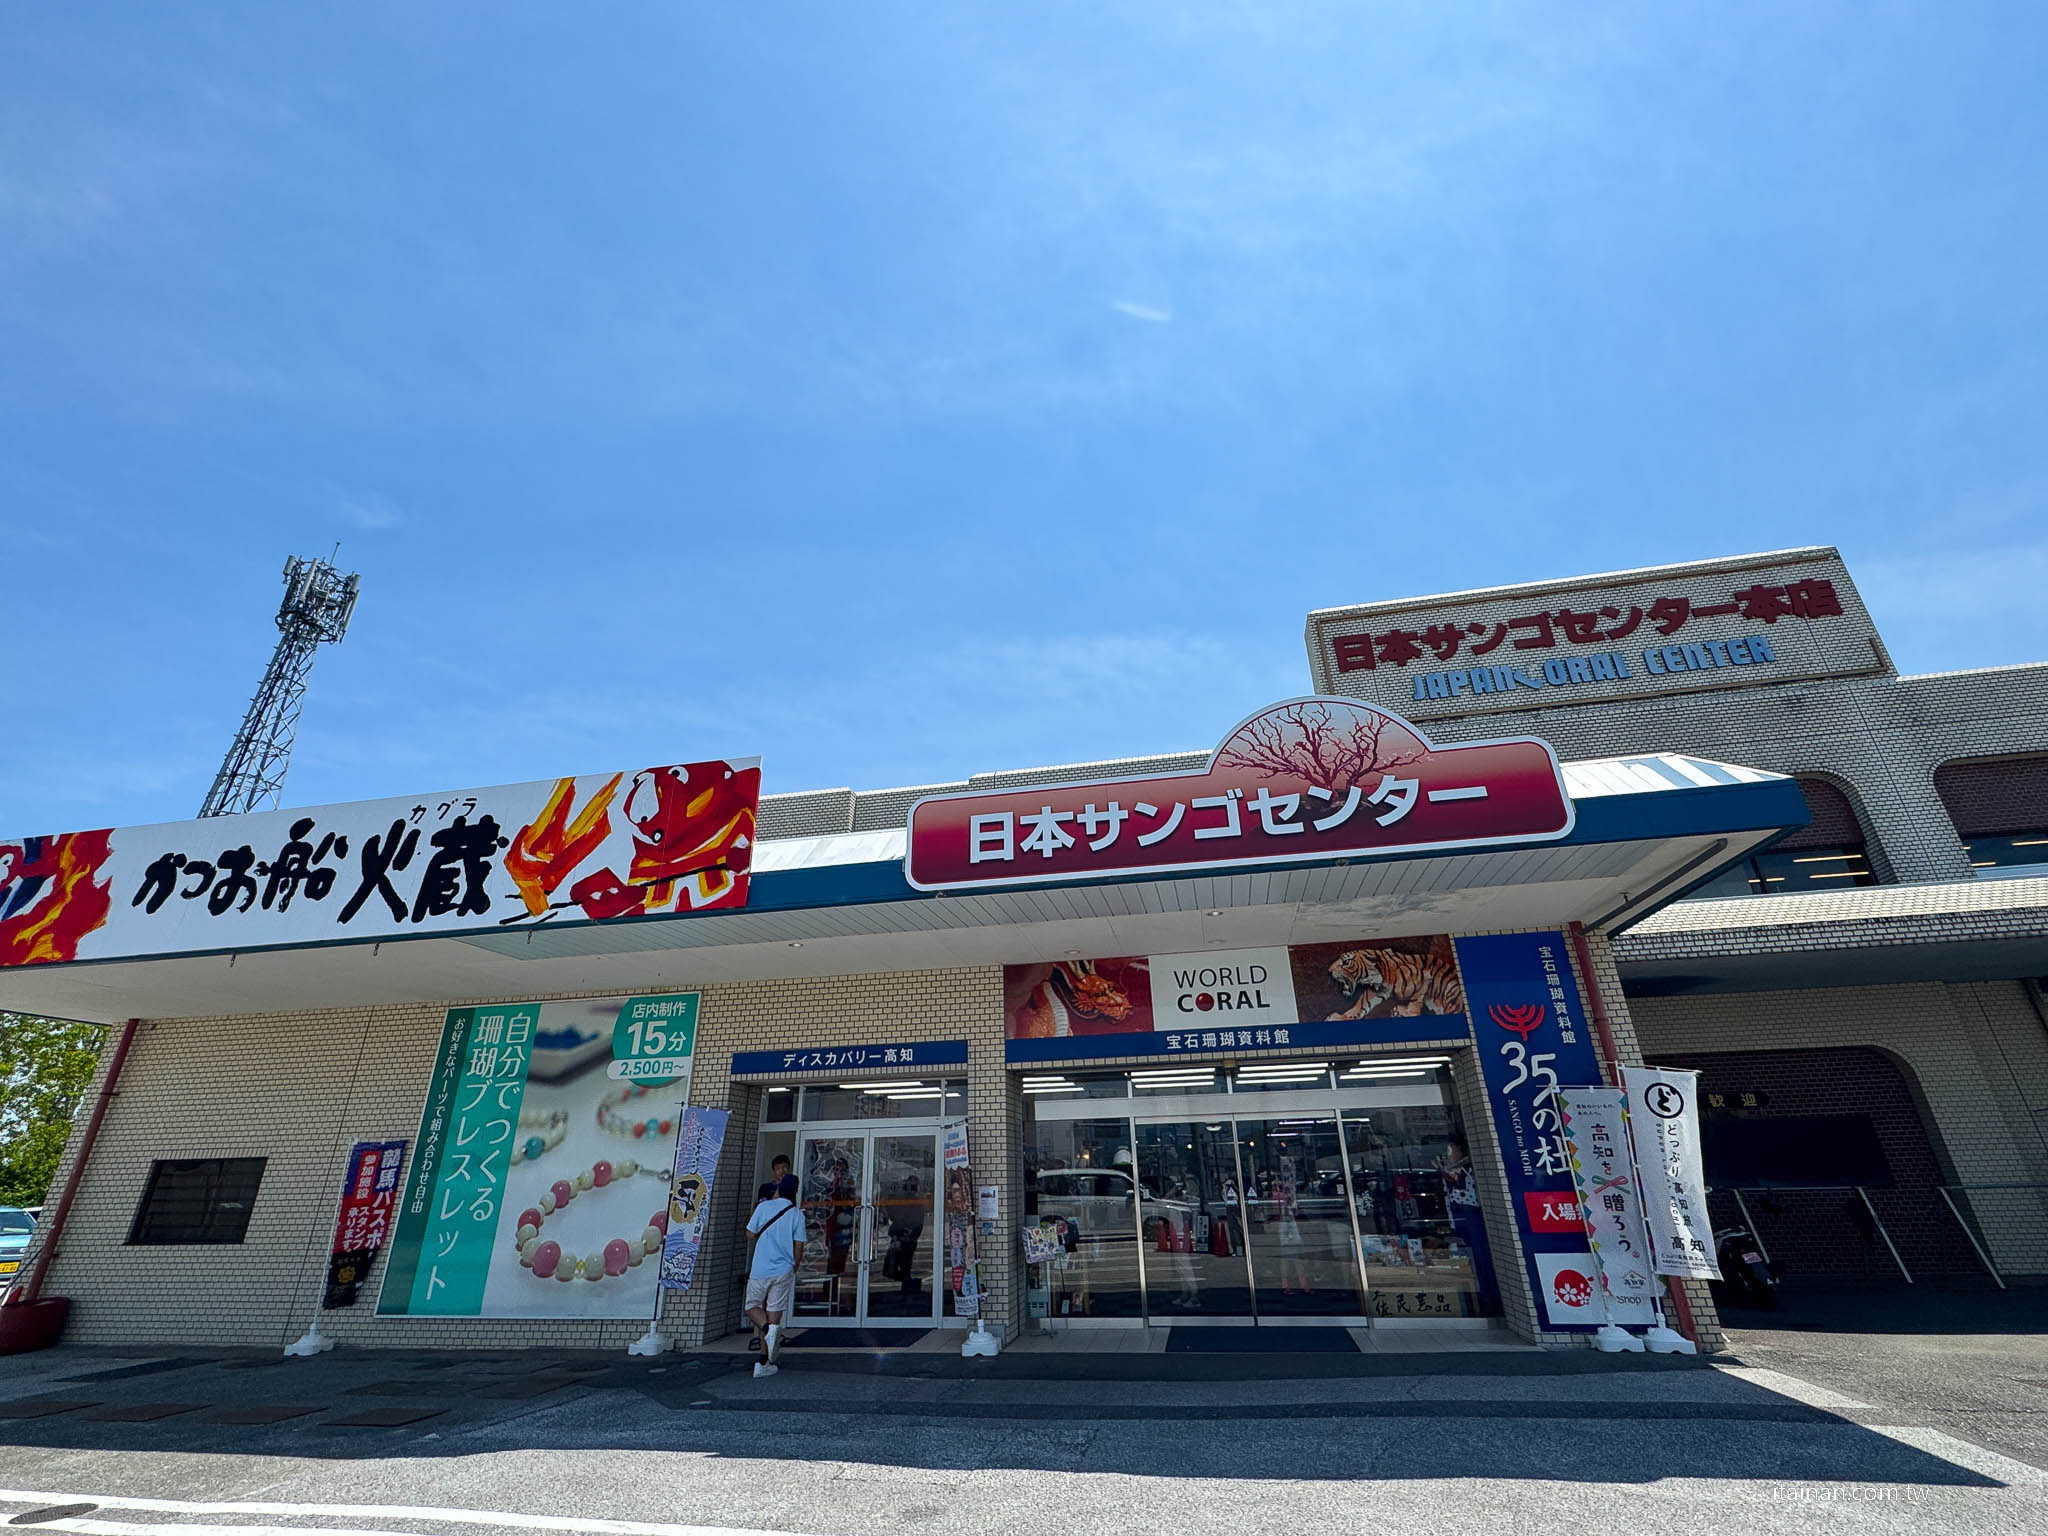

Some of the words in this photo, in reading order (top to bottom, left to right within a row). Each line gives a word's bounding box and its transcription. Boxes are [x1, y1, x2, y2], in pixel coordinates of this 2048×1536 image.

[1333, 579, 1844, 673] 日本サンゴセンター本店
[1413, 664, 1516, 700] JAPAN
[1645, 636, 1777, 675] CENTER
[409, 798, 478, 824] カグラ
[969, 774, 1489, 865] 日本サンゴセンター
[1173, 965, 1268, 989] WORLD
[631, 1001, 687, 1018] 店内制作
[1177, 990, 1270, 1012] CORAL
[1538, 946, 1577, 1044] 宝石珊瑚資料館
[1166, 1029, 1290, 1050] 宝石珊瑚資料館
[783, 1047, 914, 1068] ディスカバリー高知
[410, 1017, 466, 1214] お好きなパーツで組み合わせ自由
[469, 1011, 532, 1222] 自分でつくる
[1508, 1099, 1524, 1133] SANGO
[1517, 1135, 1525, 1148] no
[426, 1014, 505, 1301] 珊瑚ブレスレット
[1518, 1150, 1534, 1176] MORI
[353, 1207, 371, 1250] スタンプ
[1670, 1236, 1706, 1253] 高知
